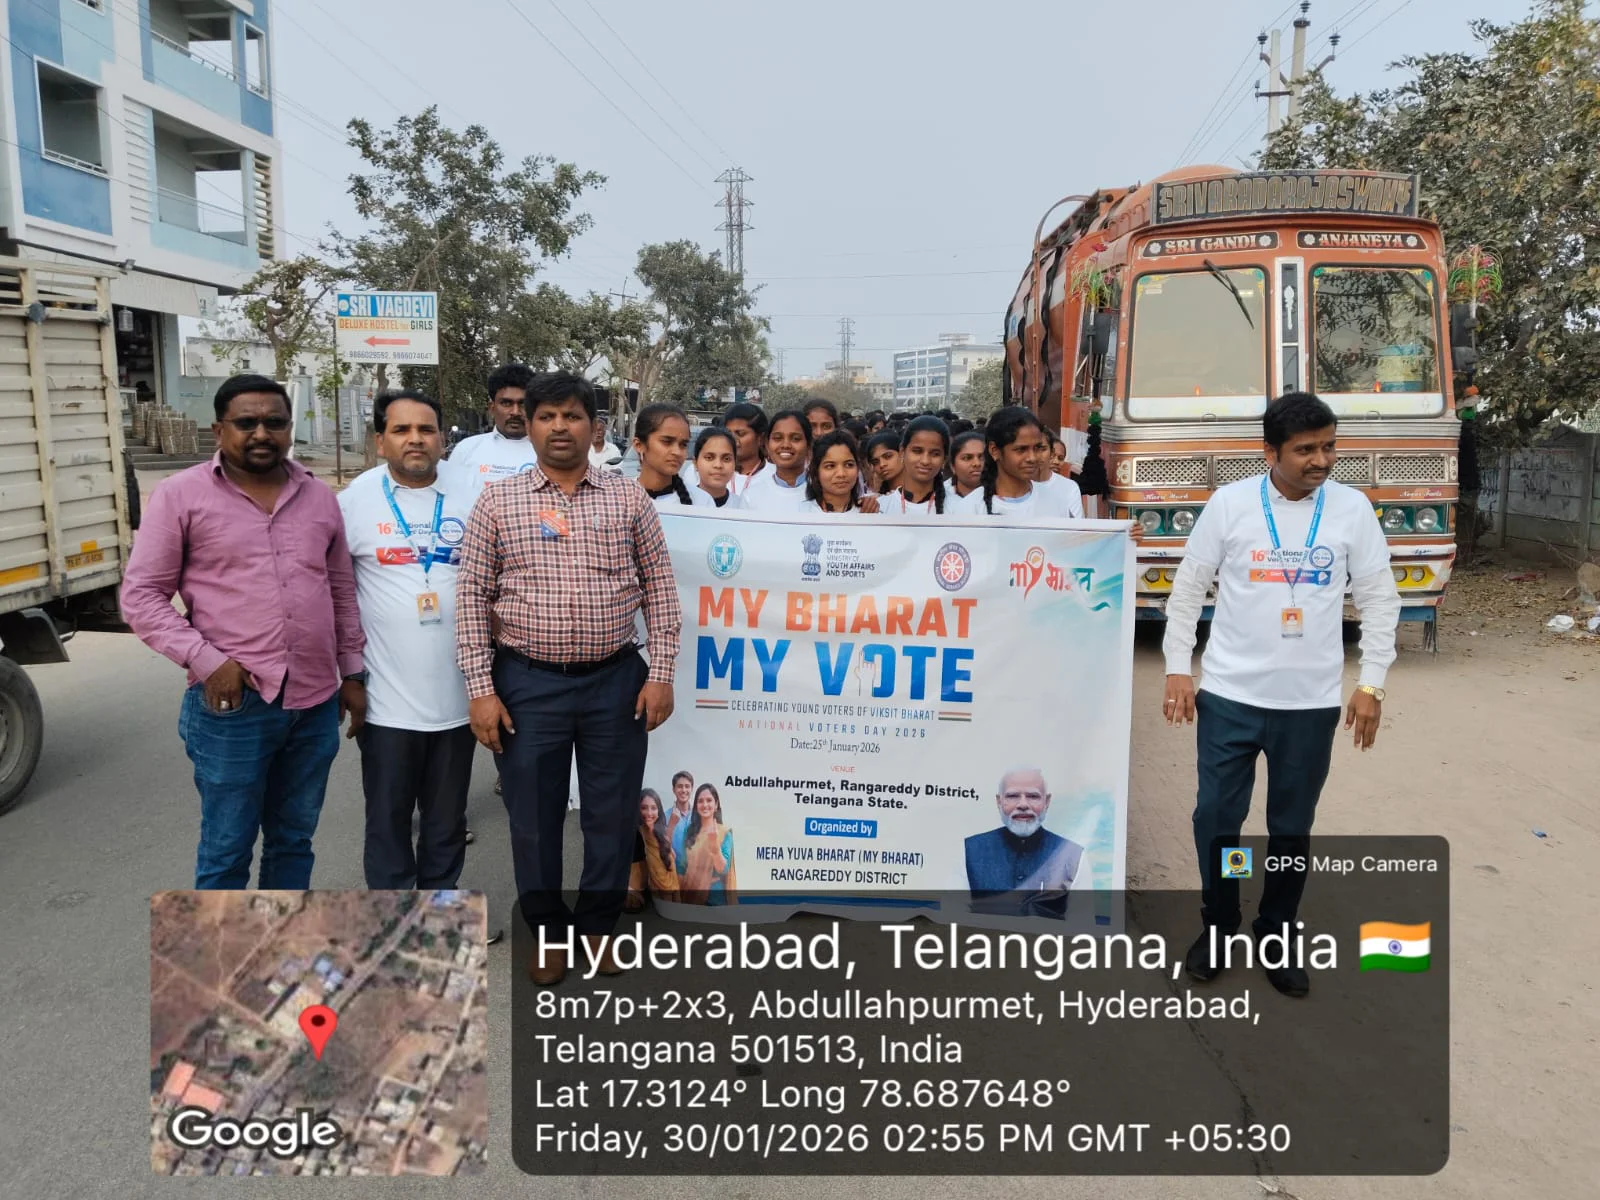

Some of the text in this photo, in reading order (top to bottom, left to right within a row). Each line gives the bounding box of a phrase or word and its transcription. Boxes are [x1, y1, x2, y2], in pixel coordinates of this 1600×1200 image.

[1165, 235, 1257, 254] SRI GANDI
[1318, 233, 1405, 248] ANJANEYA
[350, 295, 433, 318] SRI VAGDEVI
[339, 319, 368, 329] DELUXE
[370, 319, 398, 330] HOSTEL
[411, 320, 433, 330] GIRLS
[826, 569, 866, 578] AND SPORTS
[1045, 562, 1096, 592] भात
[698, 585, 977, 638] MY BHARAT
[695, 635, 975, 703] MY VOTE
[731, 700, 935, 720] CELEBRATING YOUNG VOTERS OF VIKSIT BHARAT
[738, 719, 926, 738] NATIONAL VOTERS DAY 2026
[829, 739, 860, 756] January
[860, 743, 881, 754] 2026
[831, 765, 855, 773] VENUE
[724, 775, 980, 800] Abdullahpurmet, Rangareddy District,
[794, 792, 908, 810] Telangana State.
[809, 820, 873, 836] Organized by
[756, 847, 924, 869] MERA YUVA BHARAT (MY BHARAT)
[771, 868, 908, 884] RANGAREDDY DISTRICT
